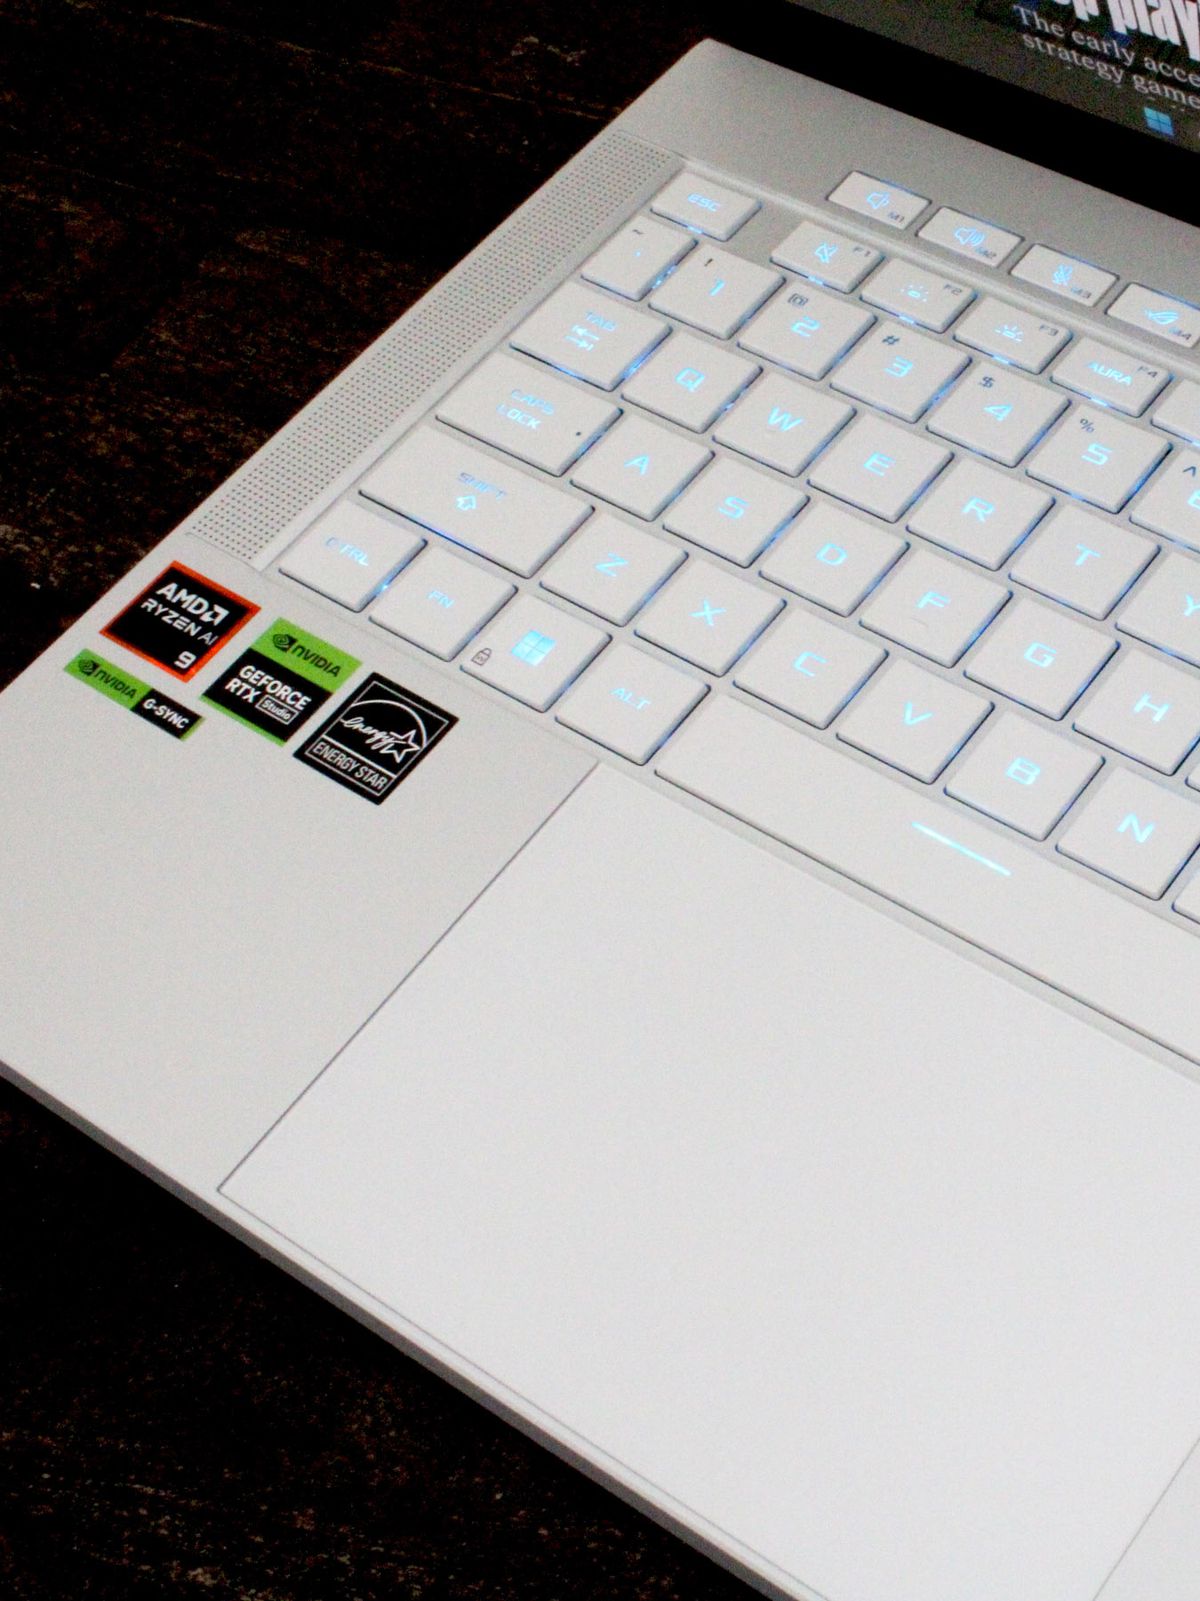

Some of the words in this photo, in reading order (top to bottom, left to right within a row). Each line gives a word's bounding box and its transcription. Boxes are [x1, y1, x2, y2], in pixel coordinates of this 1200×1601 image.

[1015, 5, 1064, 37] The
[1071, 30, 1136, 67] early
[1022, 32, 1125, 84] strategy
[854, 246, 872, 258] F1
[710, 279, 725, 296] 1
[944, 283, 963, 295] F2
[787, 293, 809, 307] @
[791, 316, 820, 337] 2
[1040, 323, 1060, 336] F3
[882, 335, 900, 345] #
[885, 356, 913, 377] 3
[1088, 362, 1131, 385] AURA
[1138, 365, 1160, 380] F4
[675, 367, 705, 392] Q
[979, 376, 994, 388] $
[768, 407, 804, 431] W
[985, 404, 1012, 421] 4
[1080, 418, 1094, 433] %
[624, 454, 650, 475] A
[864, 452, 893, 476] E
[1082, 443, 1111, 465] 5
[719, 496, 747, 518] S
[963, 497, 995, 522] R
[596, 553, 628, 576] Z
[816, 543, 847, 565] D
[1076, 545, 1099, 565] T
[156, 582, 211, 619] AMD
[429, 591, 453, 608] FN
[918, 591, 948, 608] F
[140, 598, 201, 639] RYZEN
[198, 629, 220, 647] AI
[692, 600, 725, 626] X
[175, 650, 197, 671] 9
[290, 637, 342, 679] NVIDIA
[794, 652, 826, 676] C
[1024, 643, 1056, 667] G
[93, 665, 139, 701] NVIDIA
[238, 664, 313, 712] GEFORCE
[224, 676, 261, 705] RTX
[262, 697, 294, 724] Studio
[613, 688, 649, 709] ALT
[1134, 694, 1169, 722] H
[142, 697, 192, 731] G-SYNC
[904, 703, 931, 725] V
[312, 740, 359, 780] ENERGY
[353, 763, 389, 791] STAR
[1006, 758, 1040, 784] B
[1117, 814, 1154, 842] N
